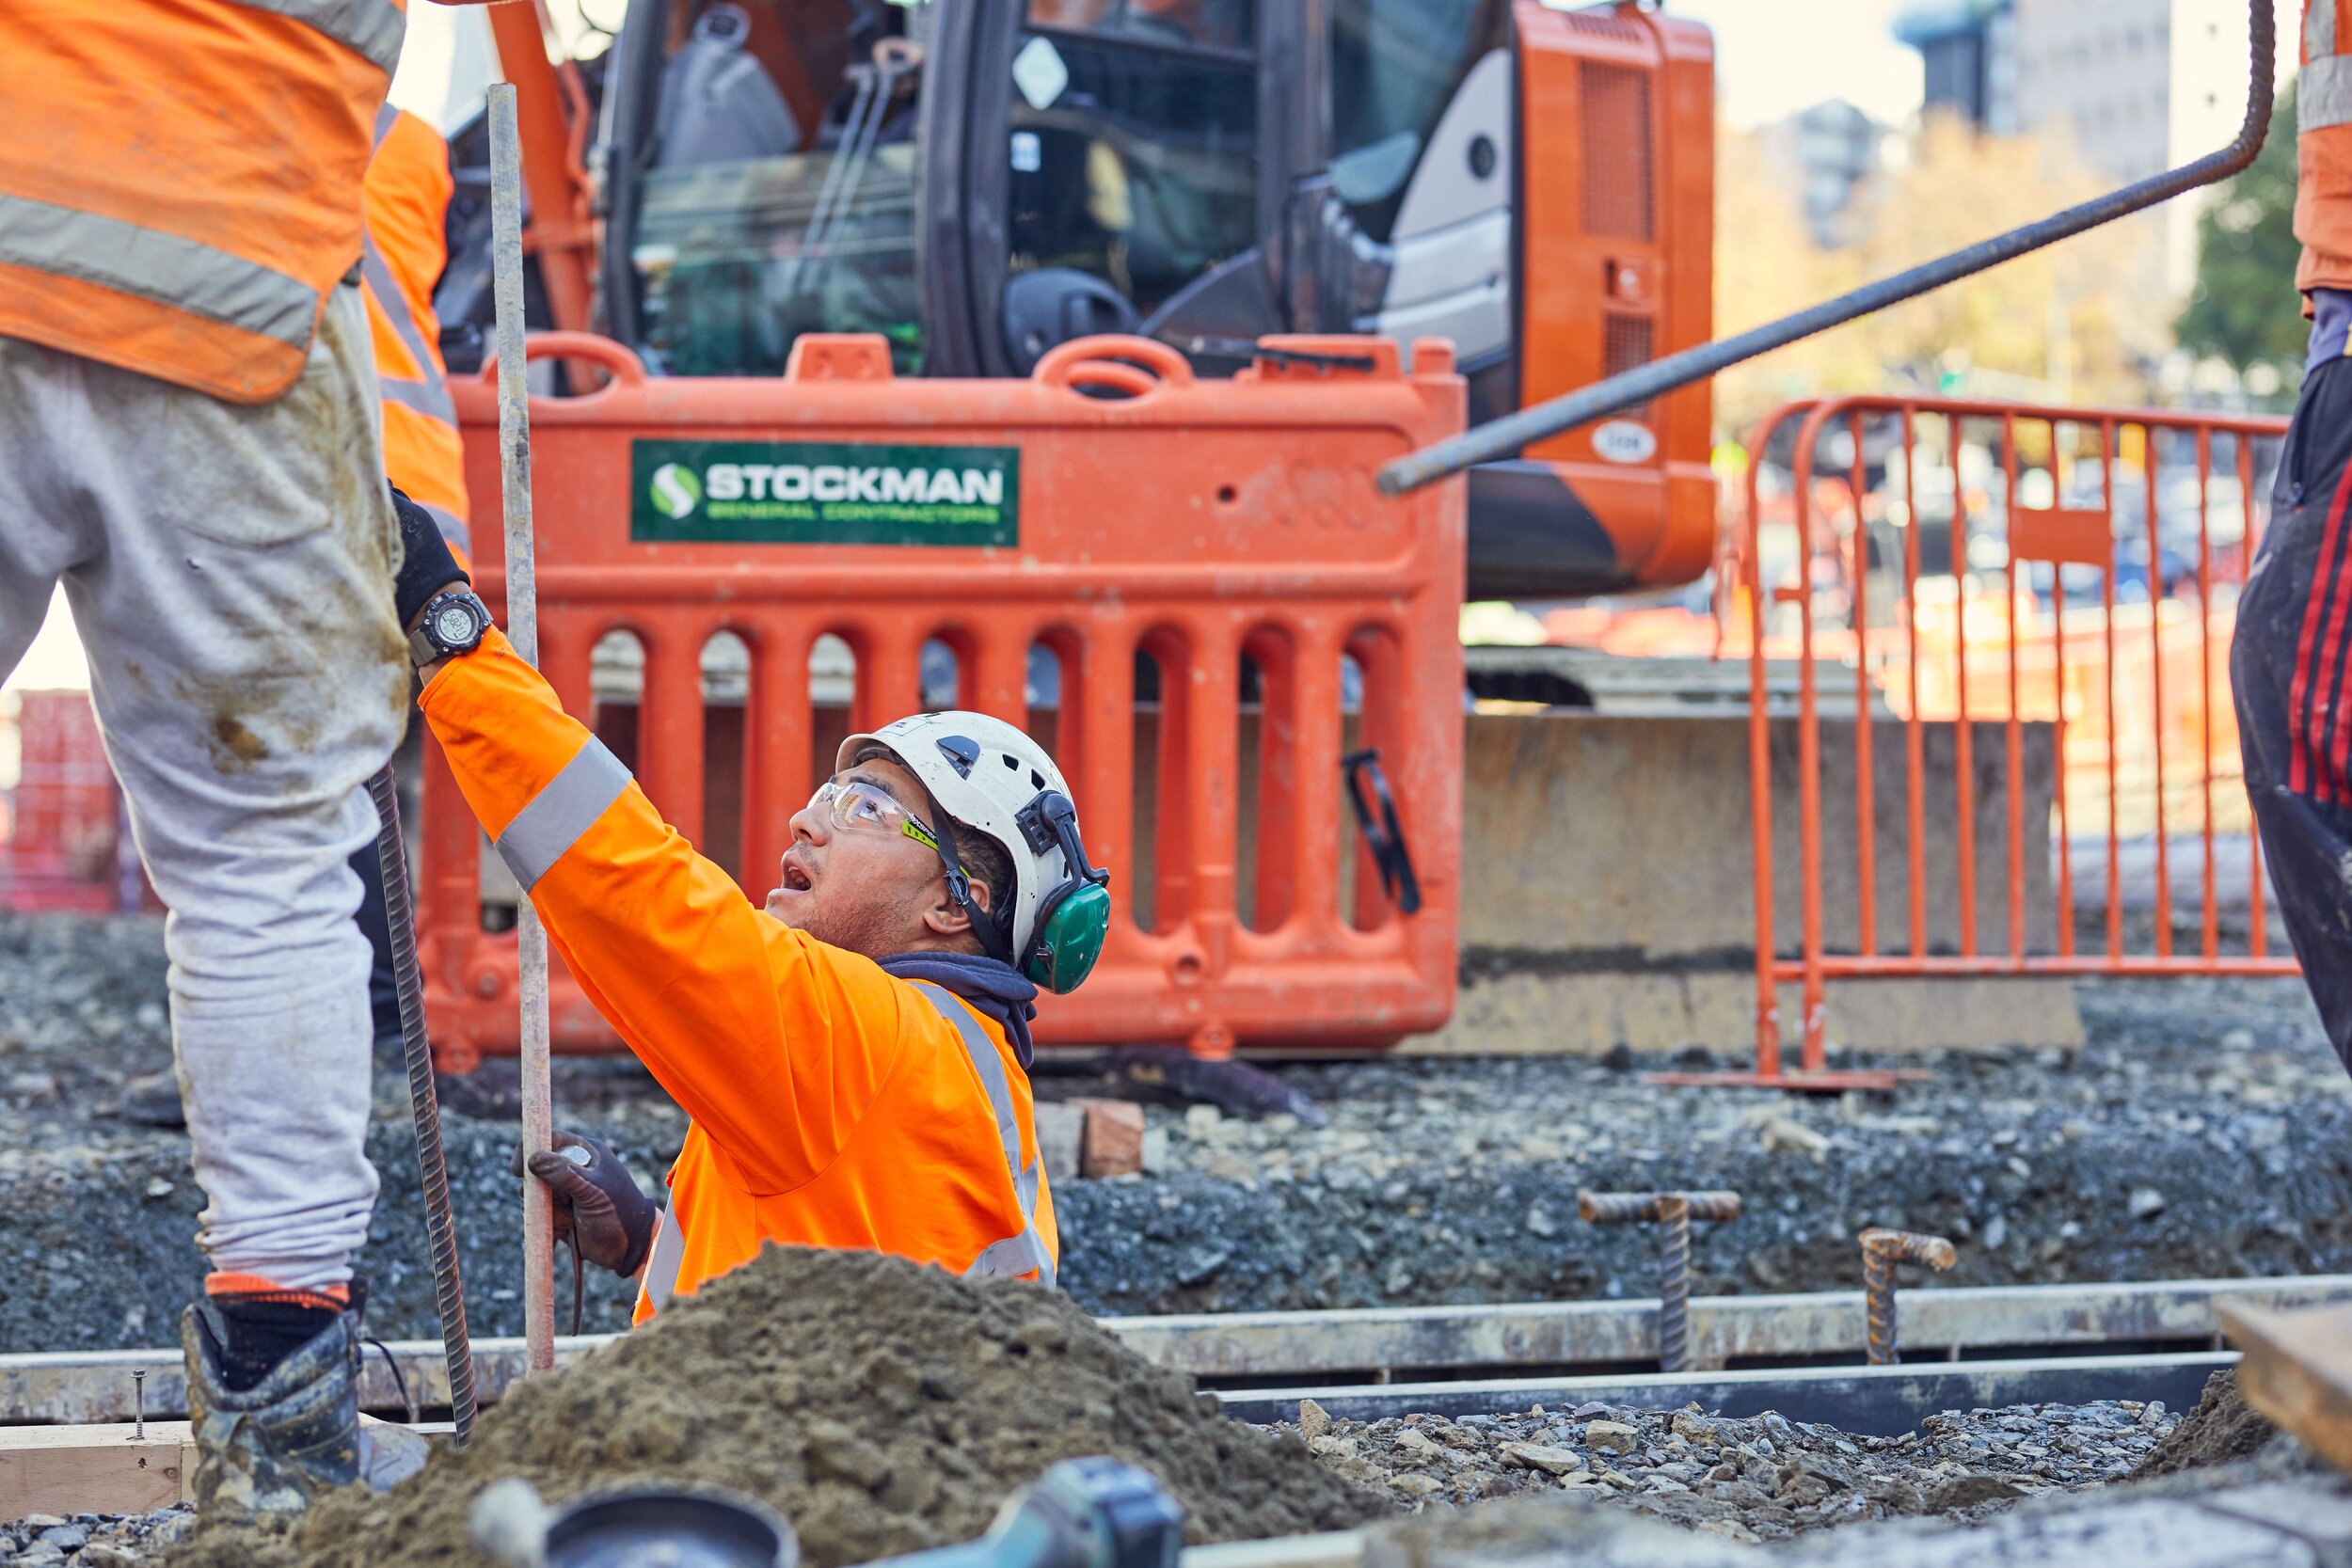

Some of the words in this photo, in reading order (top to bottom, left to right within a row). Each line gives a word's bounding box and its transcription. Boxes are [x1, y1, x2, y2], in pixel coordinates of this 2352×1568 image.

[706, 463, 1003, 504] STOCKMAN
[707, 501, 817, 519] GENERAL
[821, 502, 999, 523] CONTRACTORS
